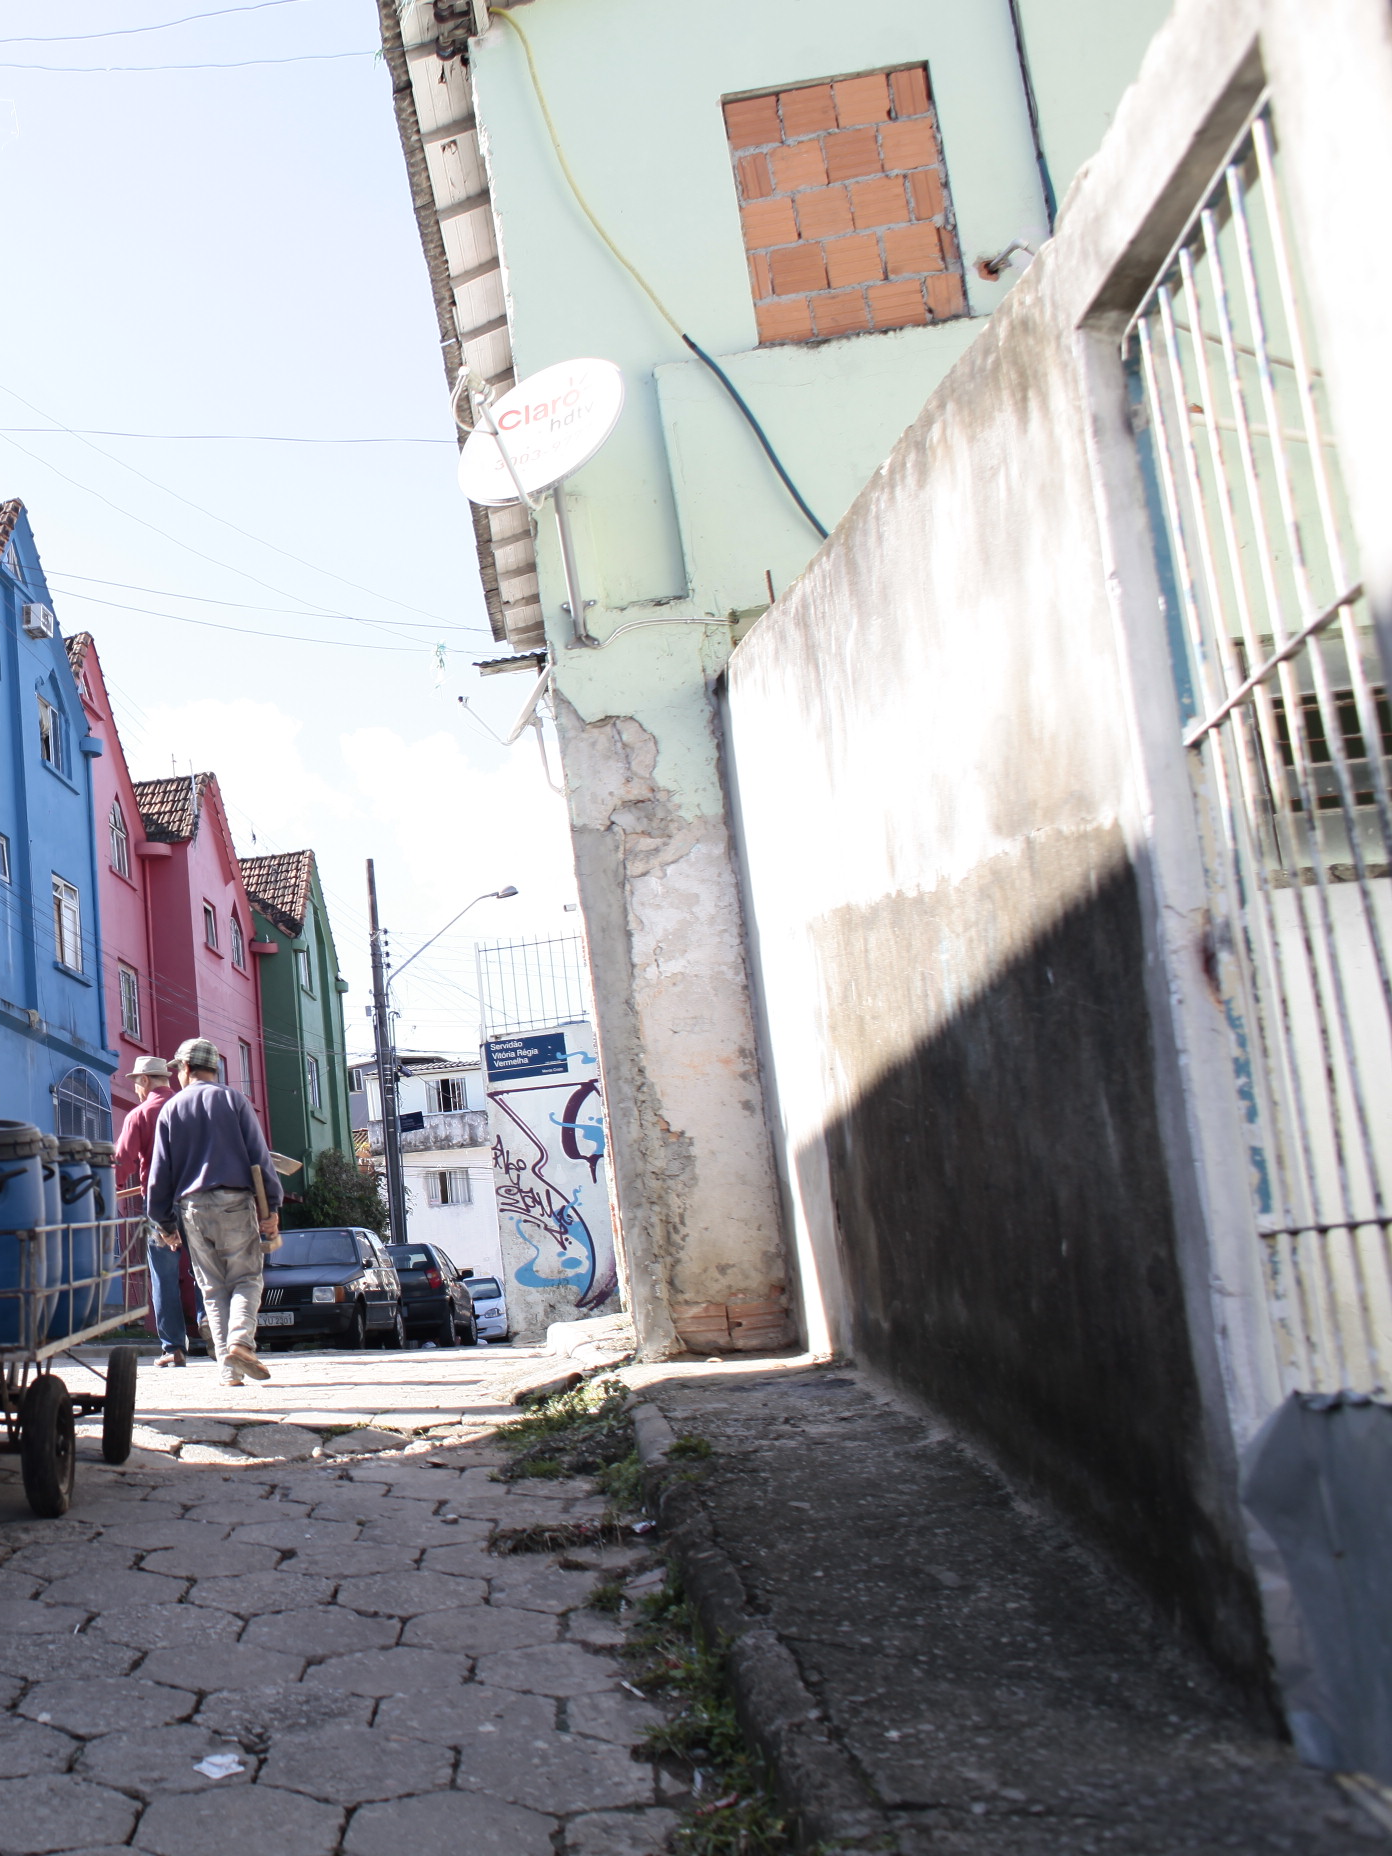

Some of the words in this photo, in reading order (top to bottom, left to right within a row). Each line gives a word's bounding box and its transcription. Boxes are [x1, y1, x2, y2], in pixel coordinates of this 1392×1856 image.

[498, 389, 580, 431] Claro
[550, 401, 595, 433] hdtv
[490, 1041, 522, 1050] Servidão
[492, 1050, 516, 1060] Vitória
[516, 1047, 539, 1058] Régia
[494, 1057, 528, 1067] Vermelha
